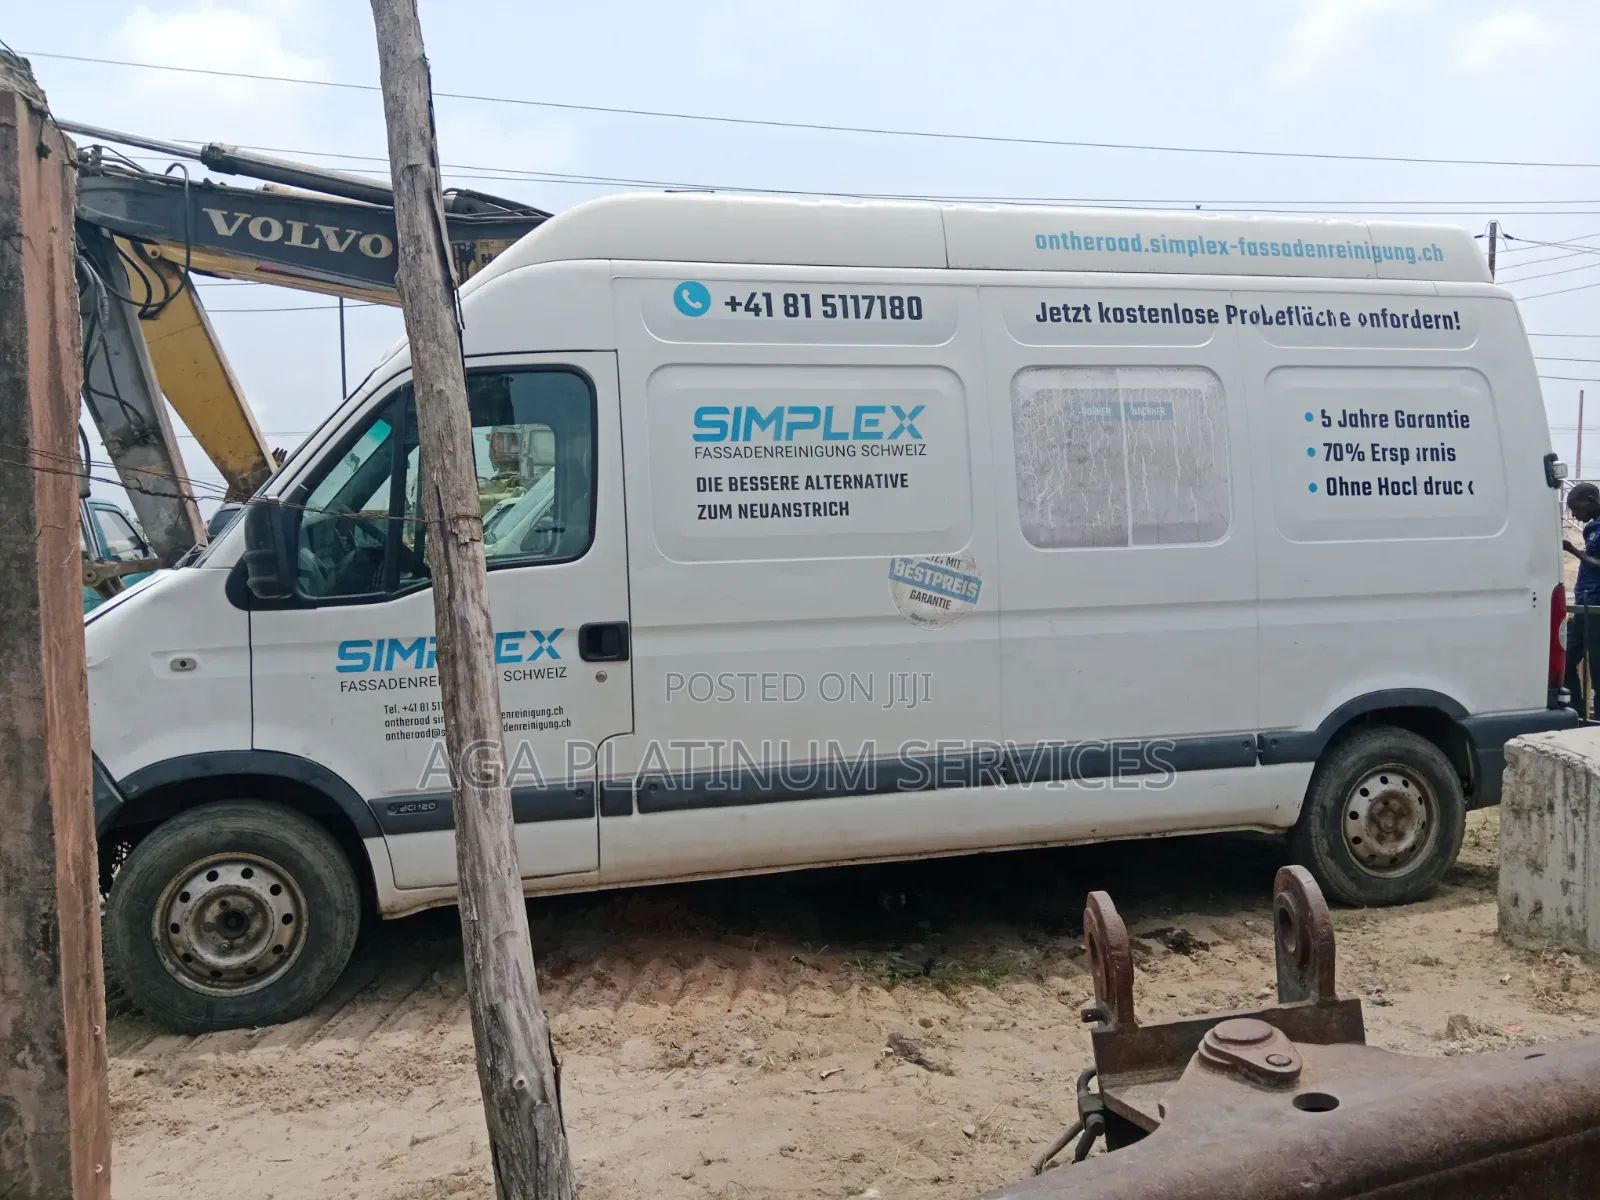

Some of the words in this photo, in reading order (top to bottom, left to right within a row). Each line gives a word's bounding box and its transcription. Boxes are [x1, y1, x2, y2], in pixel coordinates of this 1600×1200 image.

[202, 208, 393, 259] VOLVO
[1035, 231, 1444, 264] ontheroad.simplex-fassadenreinigung.ch
[725, 292, 773, 317] +41
[784, 293, 811, 318] 81
[822, 294, 923, 320] 5117180
[1035, 302, 1092, 324] Jetzt
[1098, 302, 1219, 325] kostenlose
[692, 405, 926, 442] SIMPLEX
[1321, 409, 1332, 428] 5
[1338, 408, 1389, 428] Jahre
[1395, 409, 1470, 429] Garantie
[694, 444, 857, 459] FASSADENREINIGUNG
[861, 443, 927, 457] SCHWEIZ
[1323, 442, 1365, 462] 70%
[696, 476, 723, 493] DIE
[728, 475, 800, 492] BESSERE
[804, 473, 909, 490] ALTERNATIVE
[1326, 476, 1372, 496] Ohne
[697, 504, 733, 520] ZUM
[738, 501, 850, 519] NEUANSTRICH
[946, 556, 963, 570] MIT
[893, 560, 978, 598] BESTPREIS
[909, 589, 952, 610] GARANTIE
[336, 628, 565, 673] SIMEX
[504, 667, 567, 682] SCHWEIZ
[384, 704, 400, 715] Tel.
[402, 702, 417, 713] +41
[420, 702, 429, 712] 81
[385, 715, 430, 728] ontheroad
